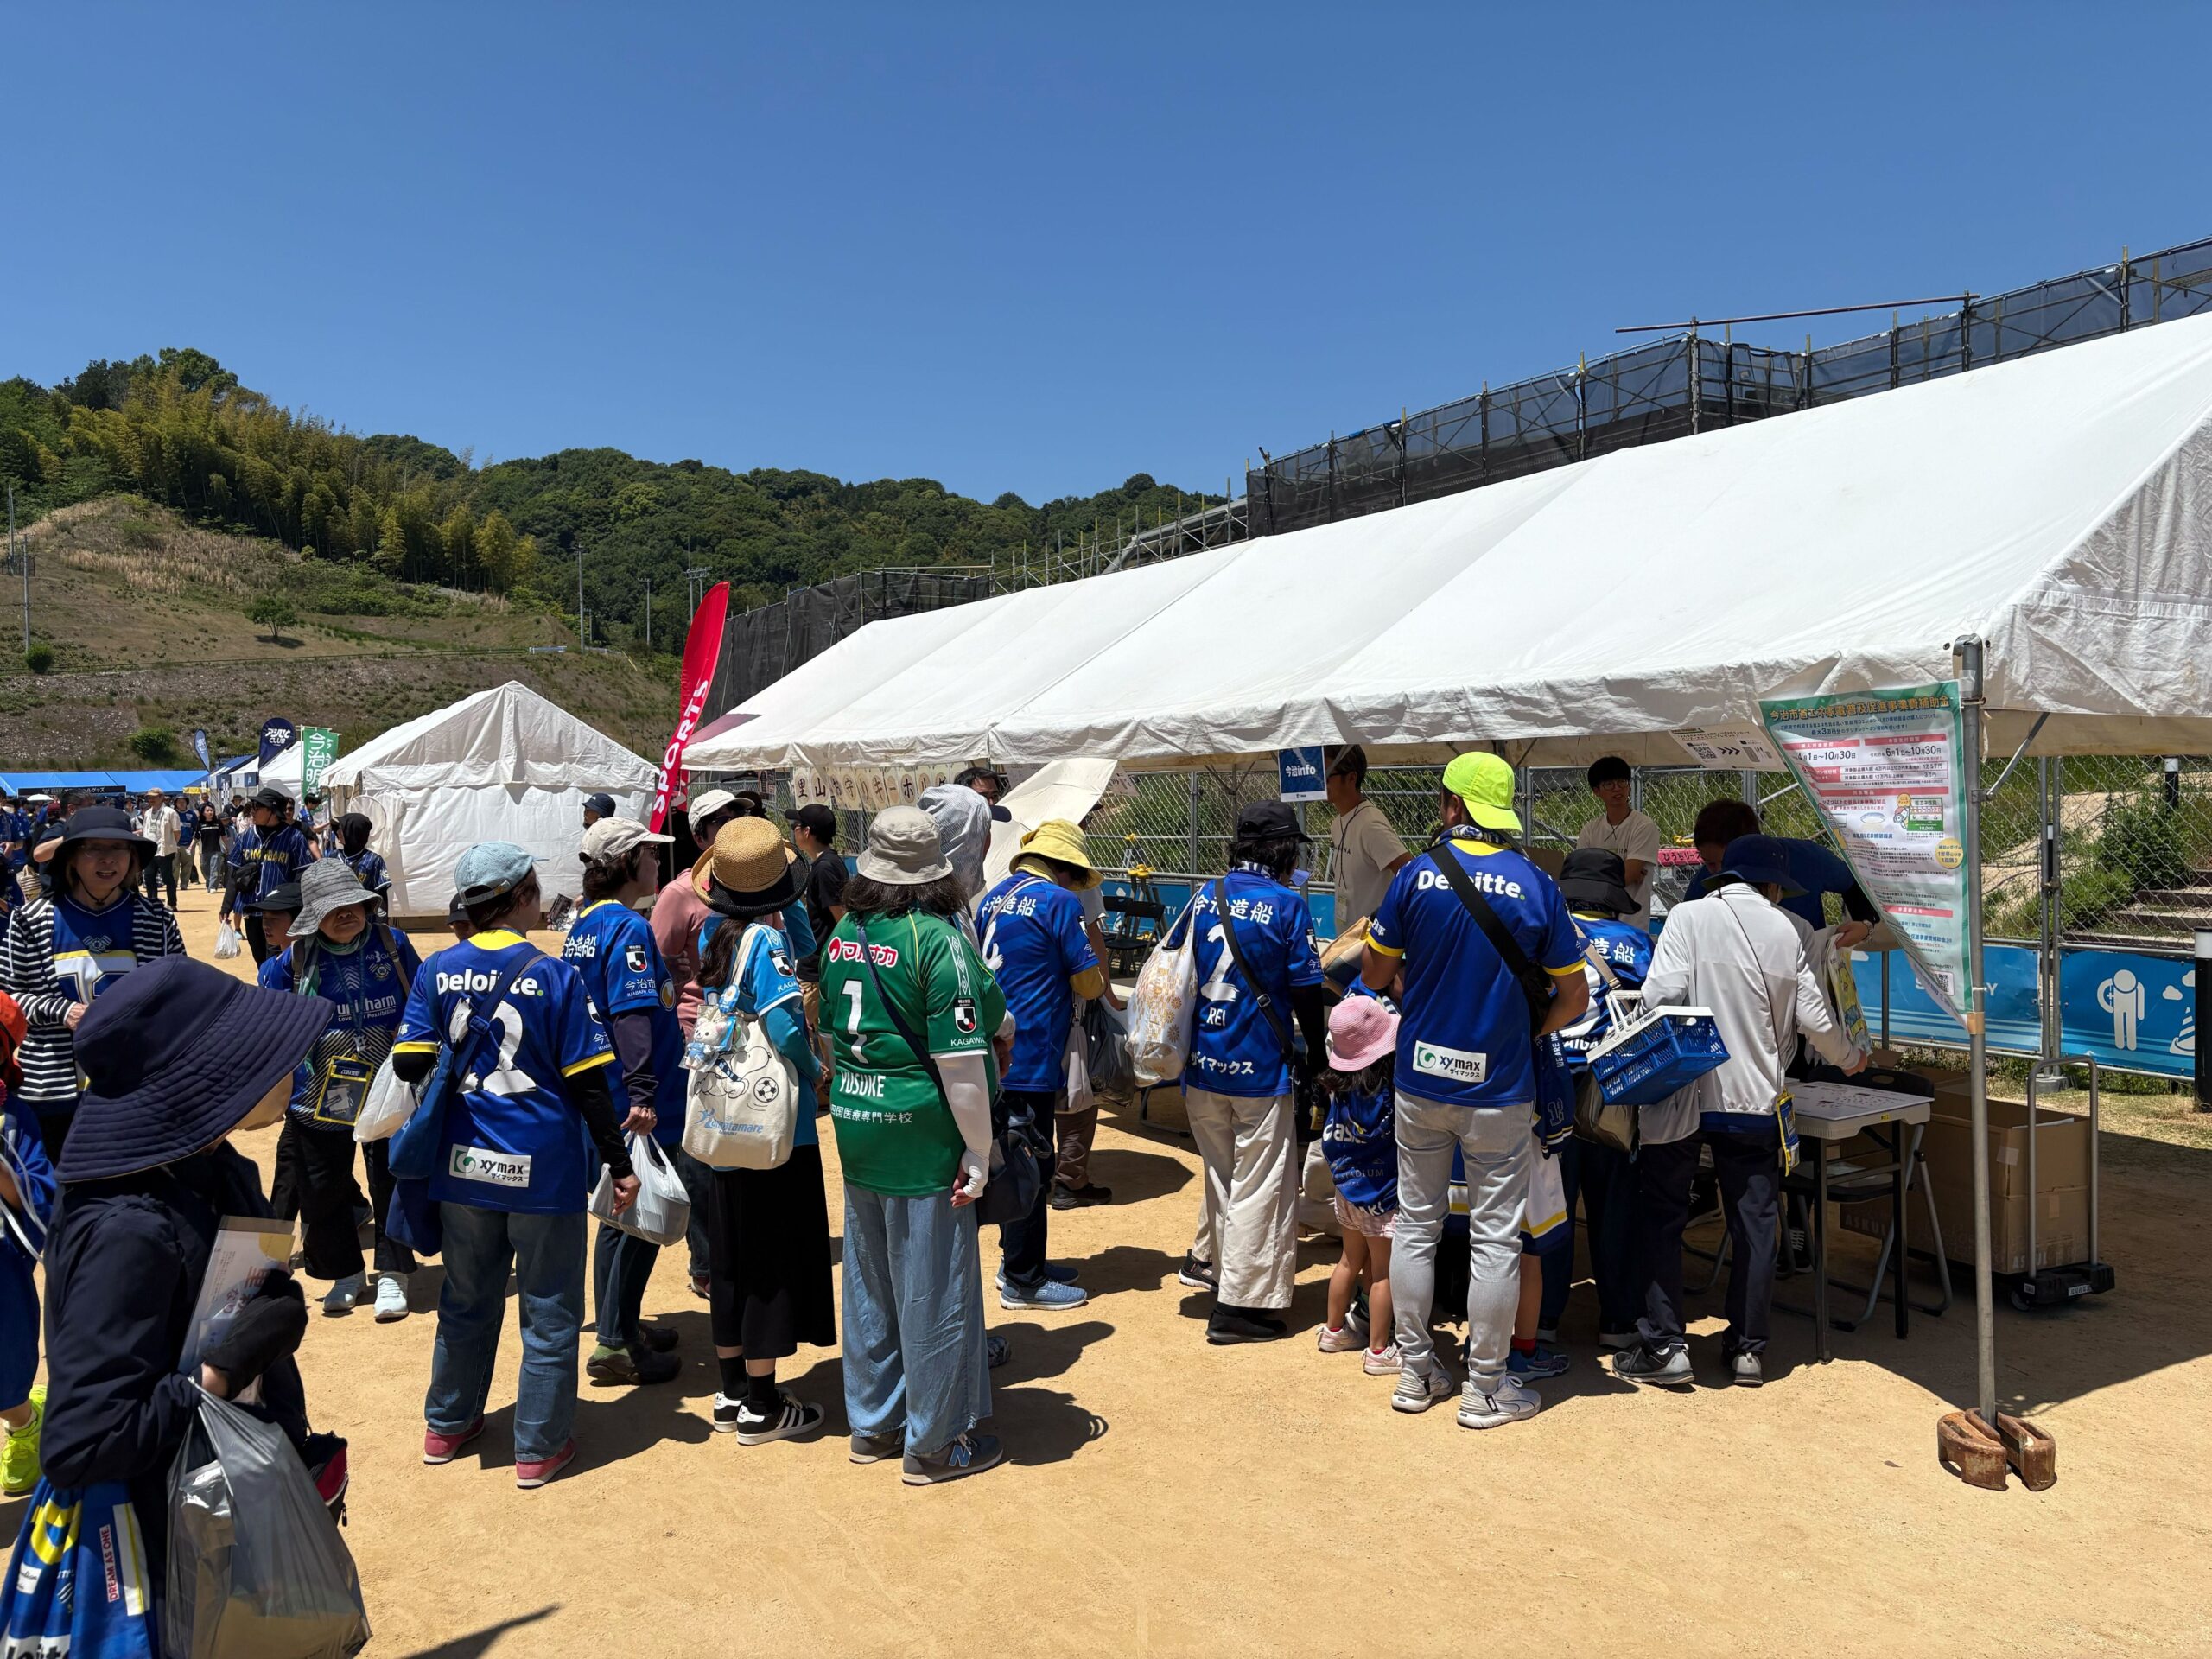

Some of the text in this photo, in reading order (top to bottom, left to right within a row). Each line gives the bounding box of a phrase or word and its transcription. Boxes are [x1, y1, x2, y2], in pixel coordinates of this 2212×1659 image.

[653, 679, 709, 814] SPORTS
[1417, 870, 1525, 901] Deitte.
[435, 969, 544, 997] Deloite.
[337, 995, 397, 1014] uiharm
[1206, 1007, 1226, 1027] REI
[950, 1037, 985, 1046] KAGAWA
[1190, 1050, 1255, 1076] ザイマックス
[1440, 1055, 1480, 1071] xymax
[1450, 1068, 1480, 1078] ザイマックス
[839, 1071, 886, 1098] YUSUKE
[830, 1103, 913, 1124] 四国医療専門学校
[480, 1158, 524, 1174] xymax
[491, 1173, 524, 1182] ザイマックス
[105, 1551, 114, 1564] AS
[106, 1566, 118, 1601] DREAM
